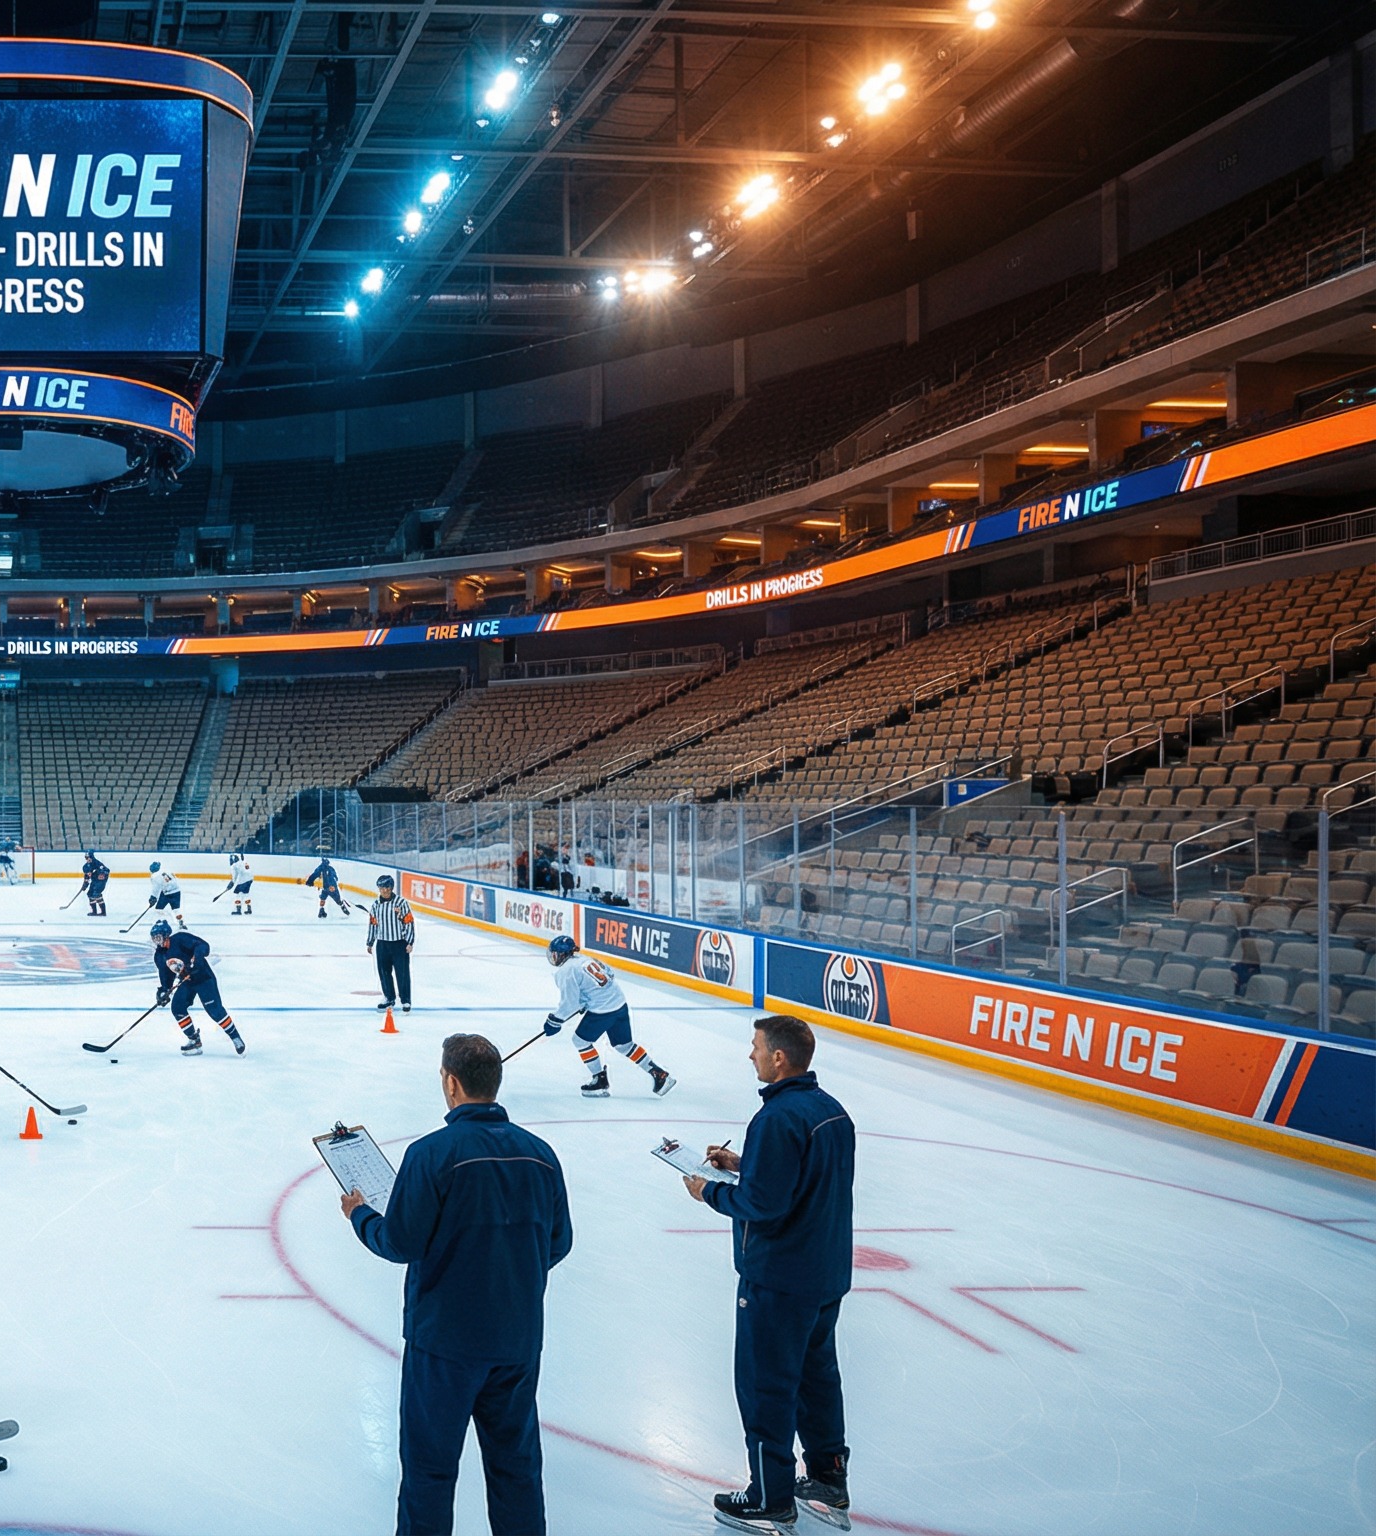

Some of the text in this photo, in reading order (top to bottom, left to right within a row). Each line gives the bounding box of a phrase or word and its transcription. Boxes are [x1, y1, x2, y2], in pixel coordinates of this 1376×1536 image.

[3, 154, 56, 217] N
[67, 153, 181, 218] ICE
[16, 231, 124, 267] DRILLS
[133, 231, 164, 267] IN
[2, 376, 29, 406] N
[34, 377, 89, 410] ICE
[1018, 481, 1119, 533] FIRE N ICE
[706, 568, 823, 609] DRILLS IN PROGRESS
[7, 641, 51, 655] DRILLS
[54, 641, 68, 654] IN
[71, 641, 138, 655] PROGRESS
[426, 620, 500, 640] FIRE N ICE
[595, 917, 671, 959] FIRE N ICE
[969, 995, 1184, 1083] FIRE N ICE
